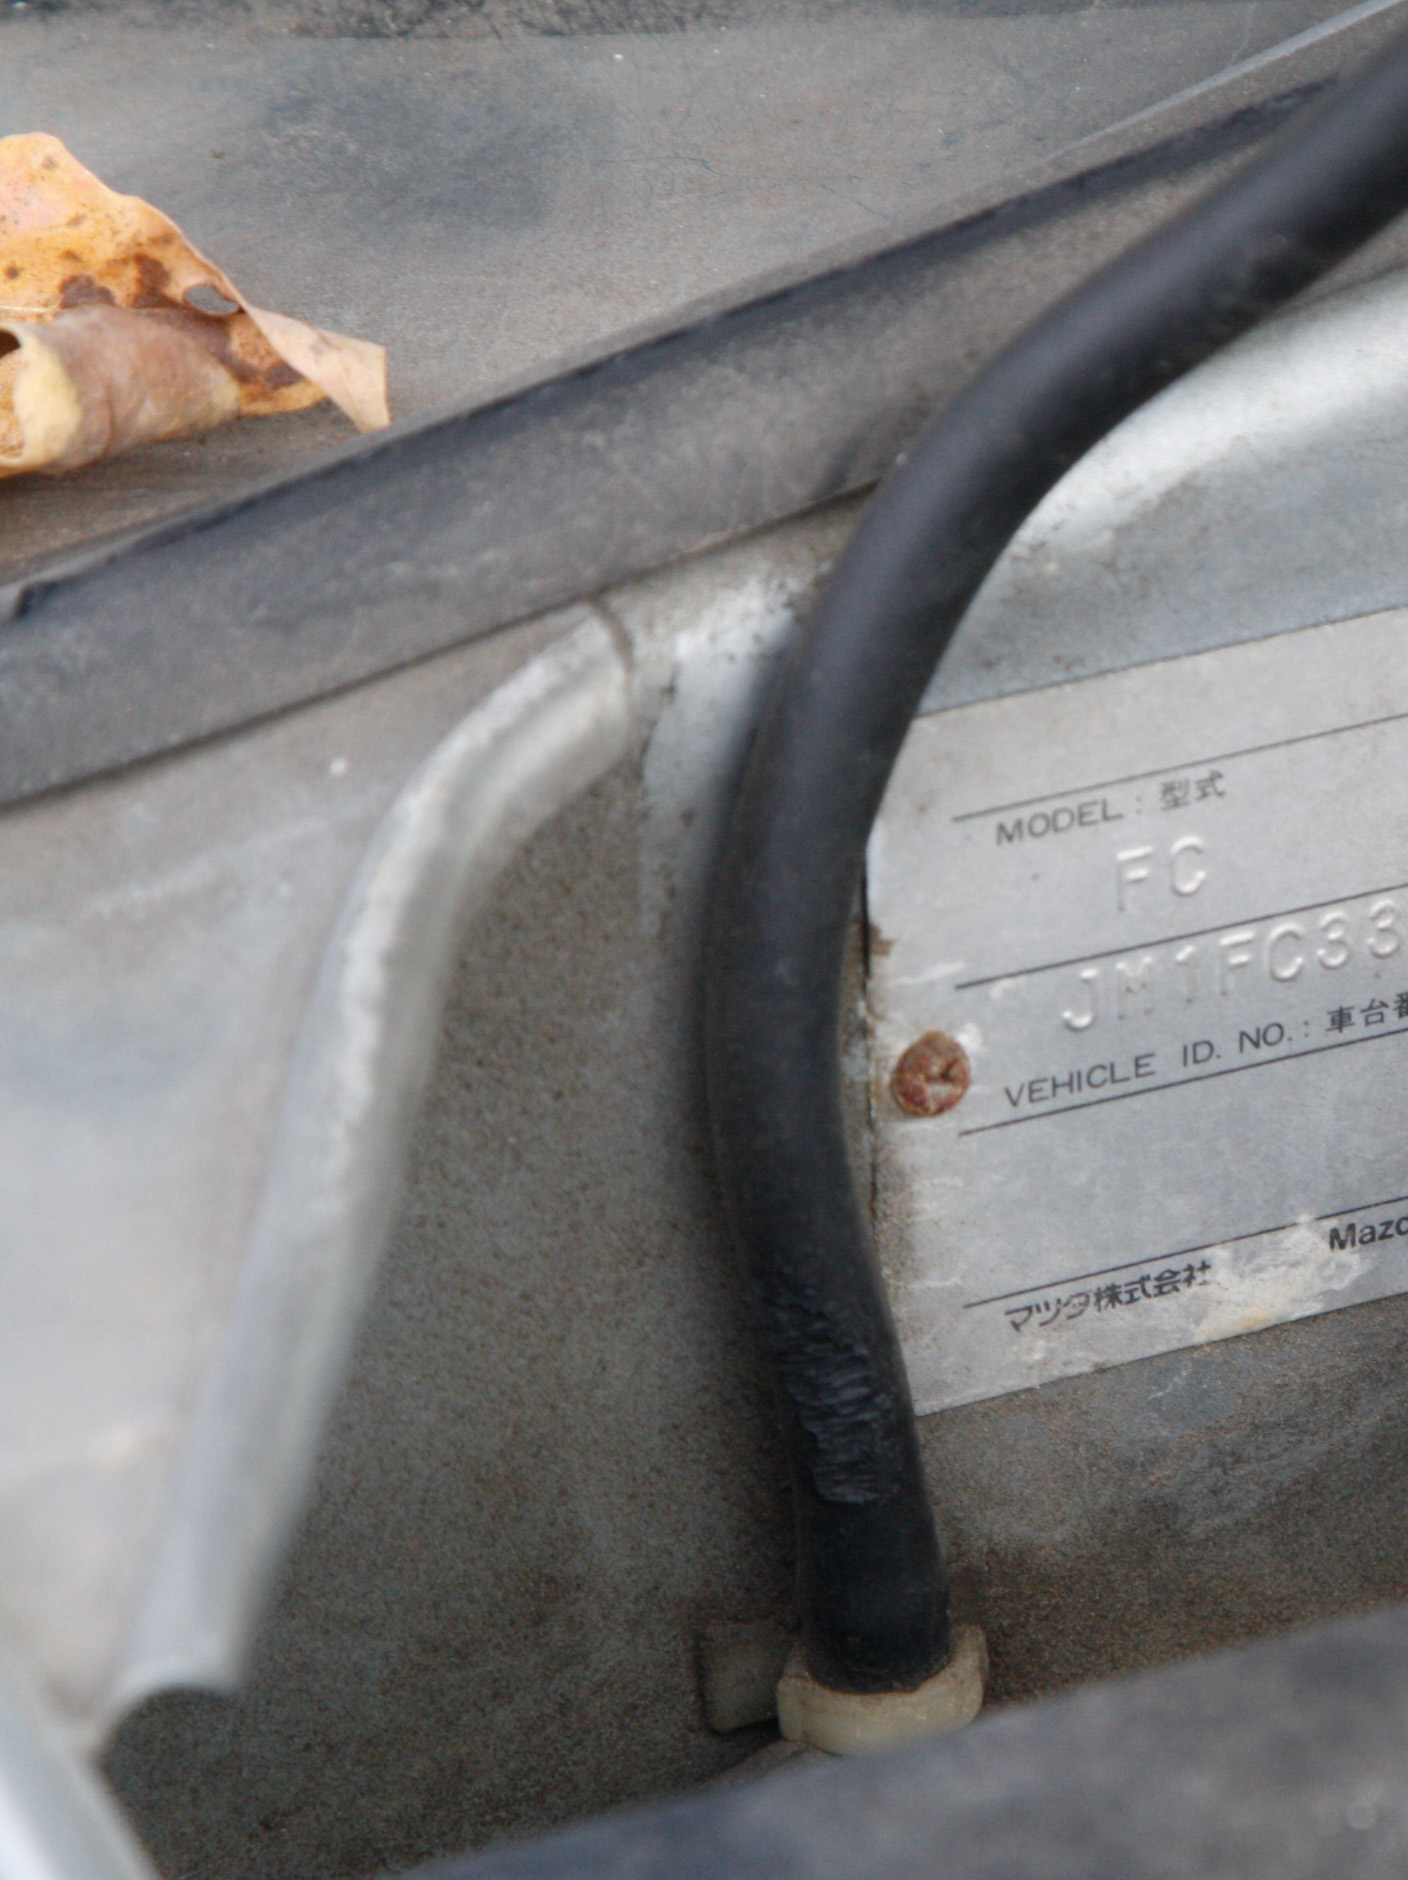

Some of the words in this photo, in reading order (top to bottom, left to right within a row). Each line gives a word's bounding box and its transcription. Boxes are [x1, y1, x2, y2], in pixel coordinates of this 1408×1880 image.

[1115, 835, 1207, 913] FC
[1004, 1052, 1156, 1109] VEHICLE
[1004, 1259, 1212, 1333] マツダ株式会社
